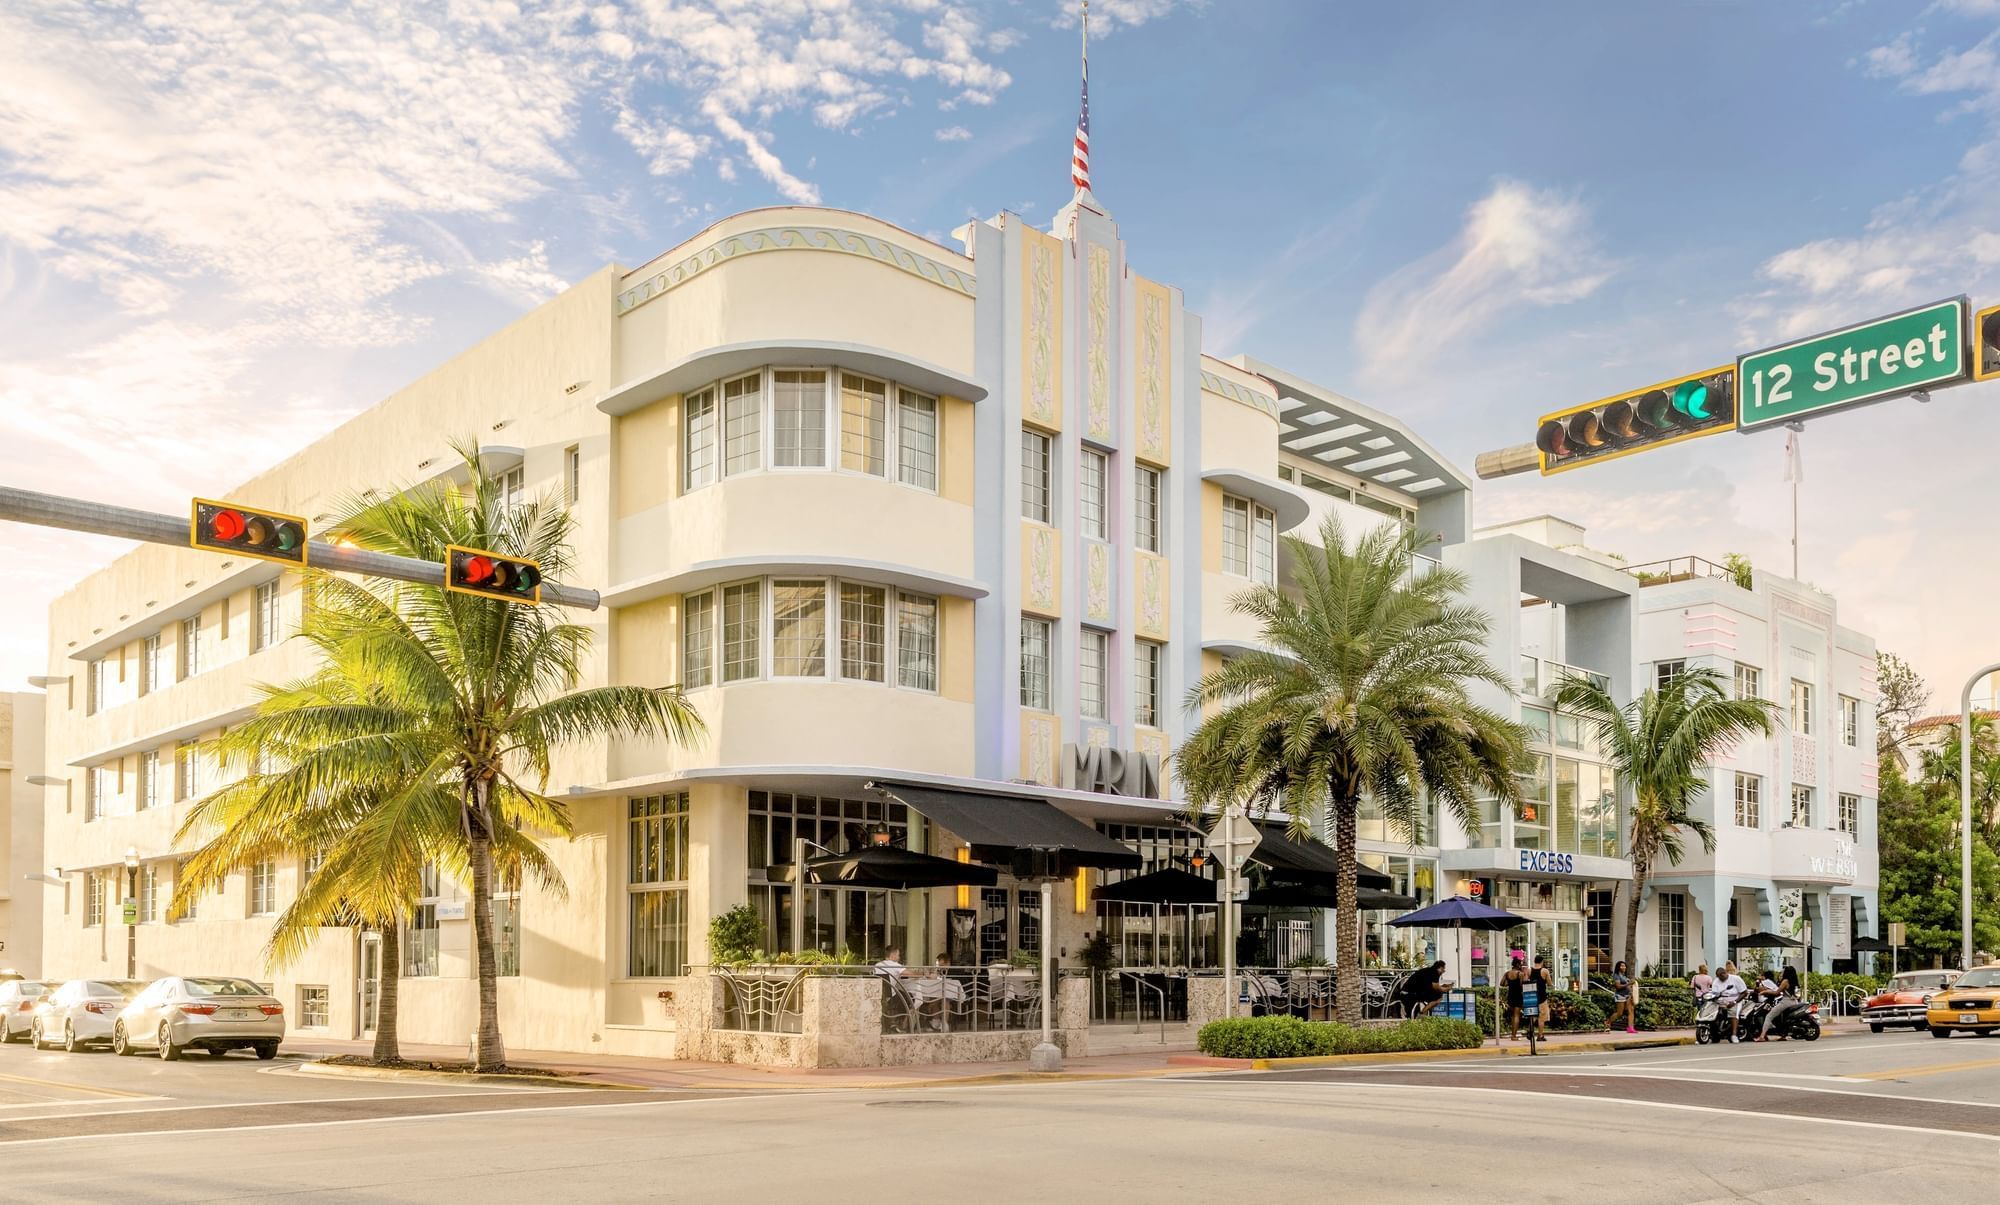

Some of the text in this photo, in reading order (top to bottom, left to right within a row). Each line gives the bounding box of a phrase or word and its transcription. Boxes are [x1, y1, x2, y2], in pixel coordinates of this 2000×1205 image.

[1752, 323, 1948, 408] 12 Street
[1520, 850, 1573, 873] EXCESS
